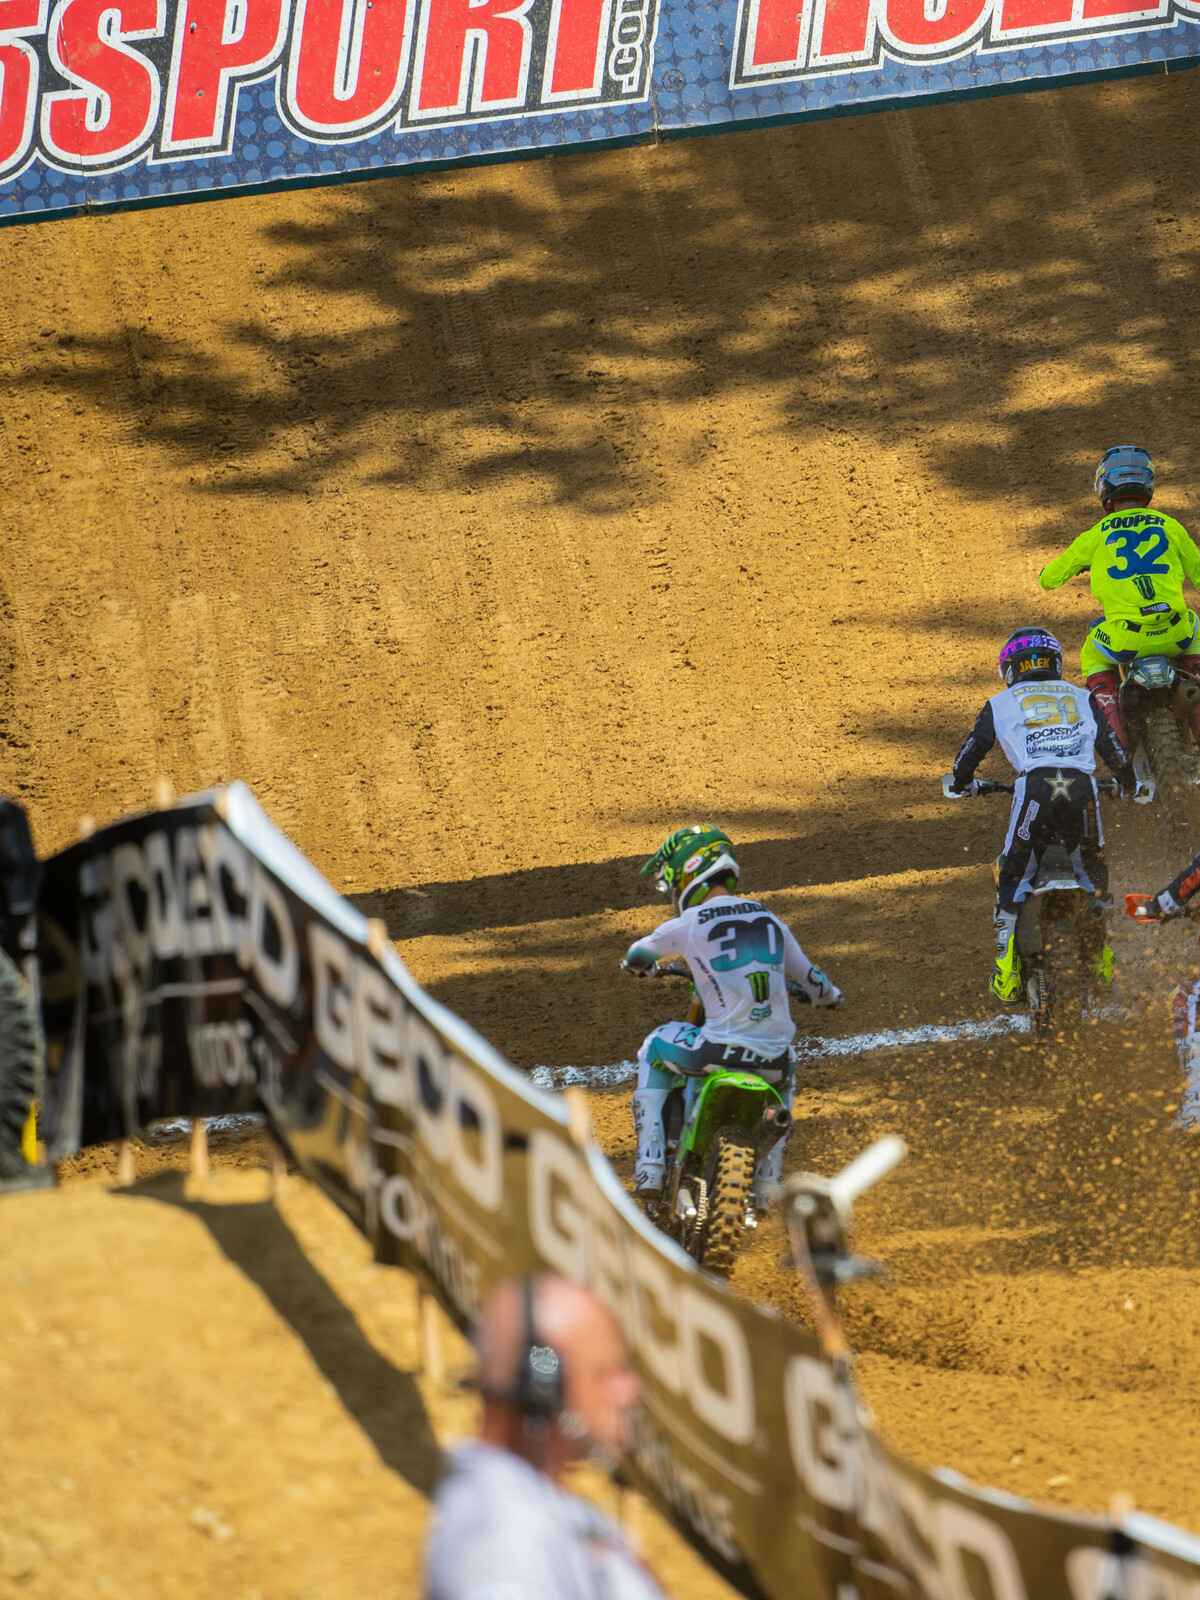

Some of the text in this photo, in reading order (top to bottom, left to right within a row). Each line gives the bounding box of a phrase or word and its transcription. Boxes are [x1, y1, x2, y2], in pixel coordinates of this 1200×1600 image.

[1101, 514, 1166, 532] COOPER
[1105, 526, 1170, 580] 32
[1145, 627, 1169, 637] THOR
[1020, 657, 1050, 673] JALEK
[1021, 694, 1080, 729] 31
[707, 916, 785, 973] 30
[722, 1045, 773, 1063] FO
